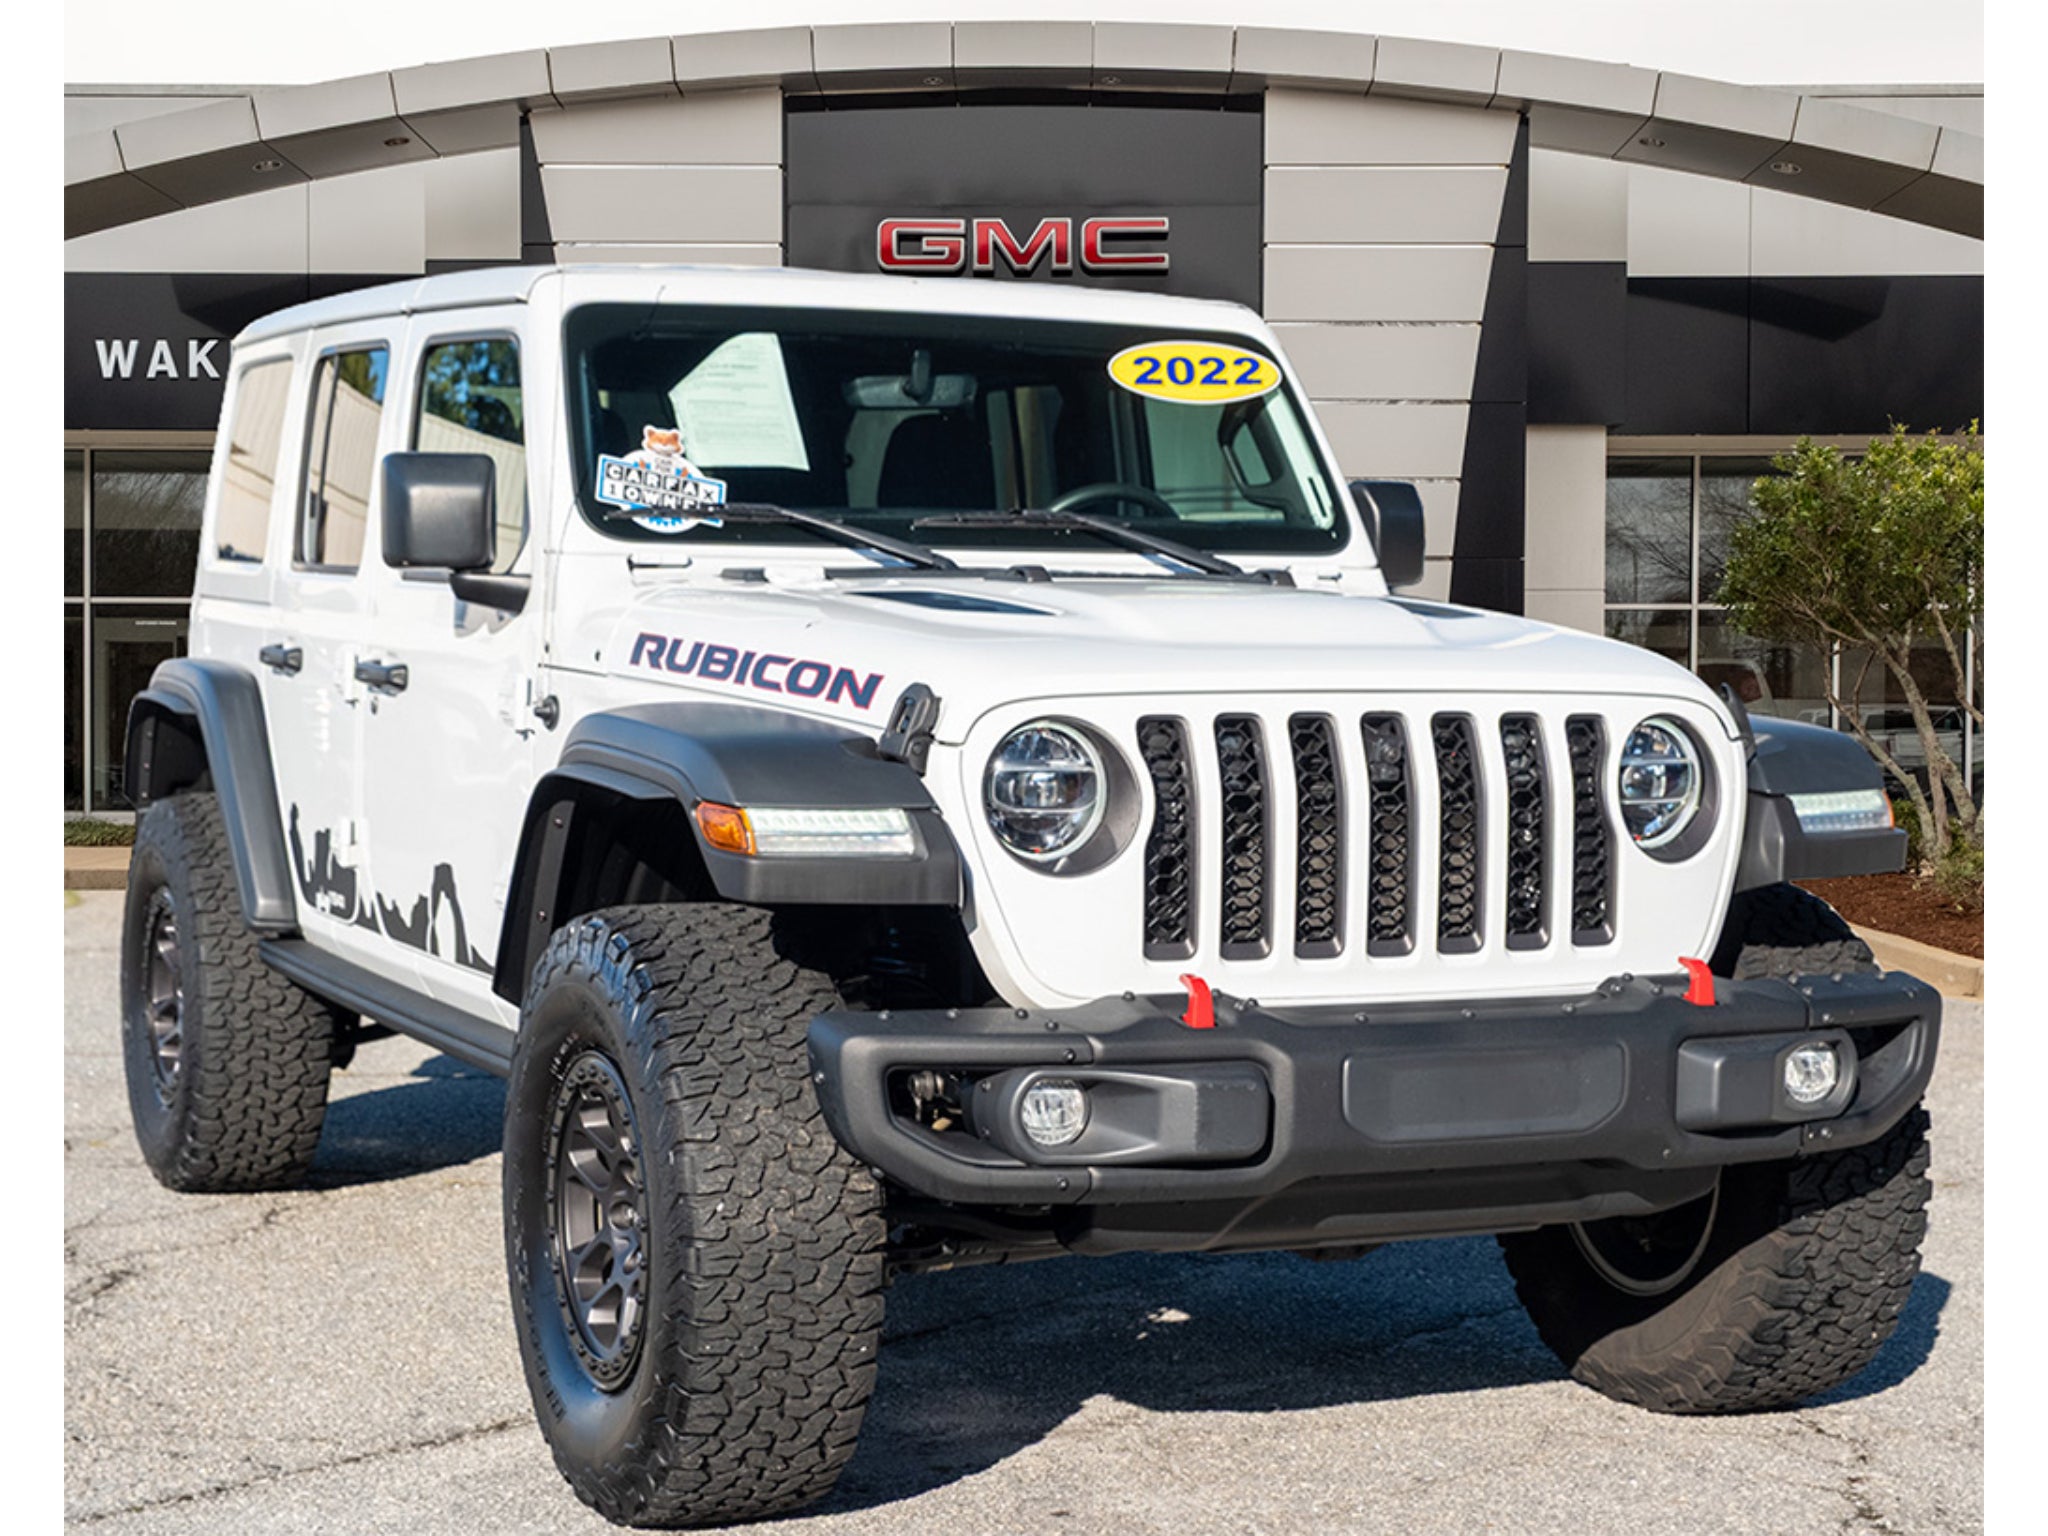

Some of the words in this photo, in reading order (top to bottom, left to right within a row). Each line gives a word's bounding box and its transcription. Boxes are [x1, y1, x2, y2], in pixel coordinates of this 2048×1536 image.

[877, 217, 1169, 270] GMC
[95, 339, 220, 379] WAK
[1133, 357, 1262, 385] 2022
[606, 463, 715, 501] CARFAX
[624, 485, 720, 511] OWNE
[629, 632, 885, 710] RUBICON
